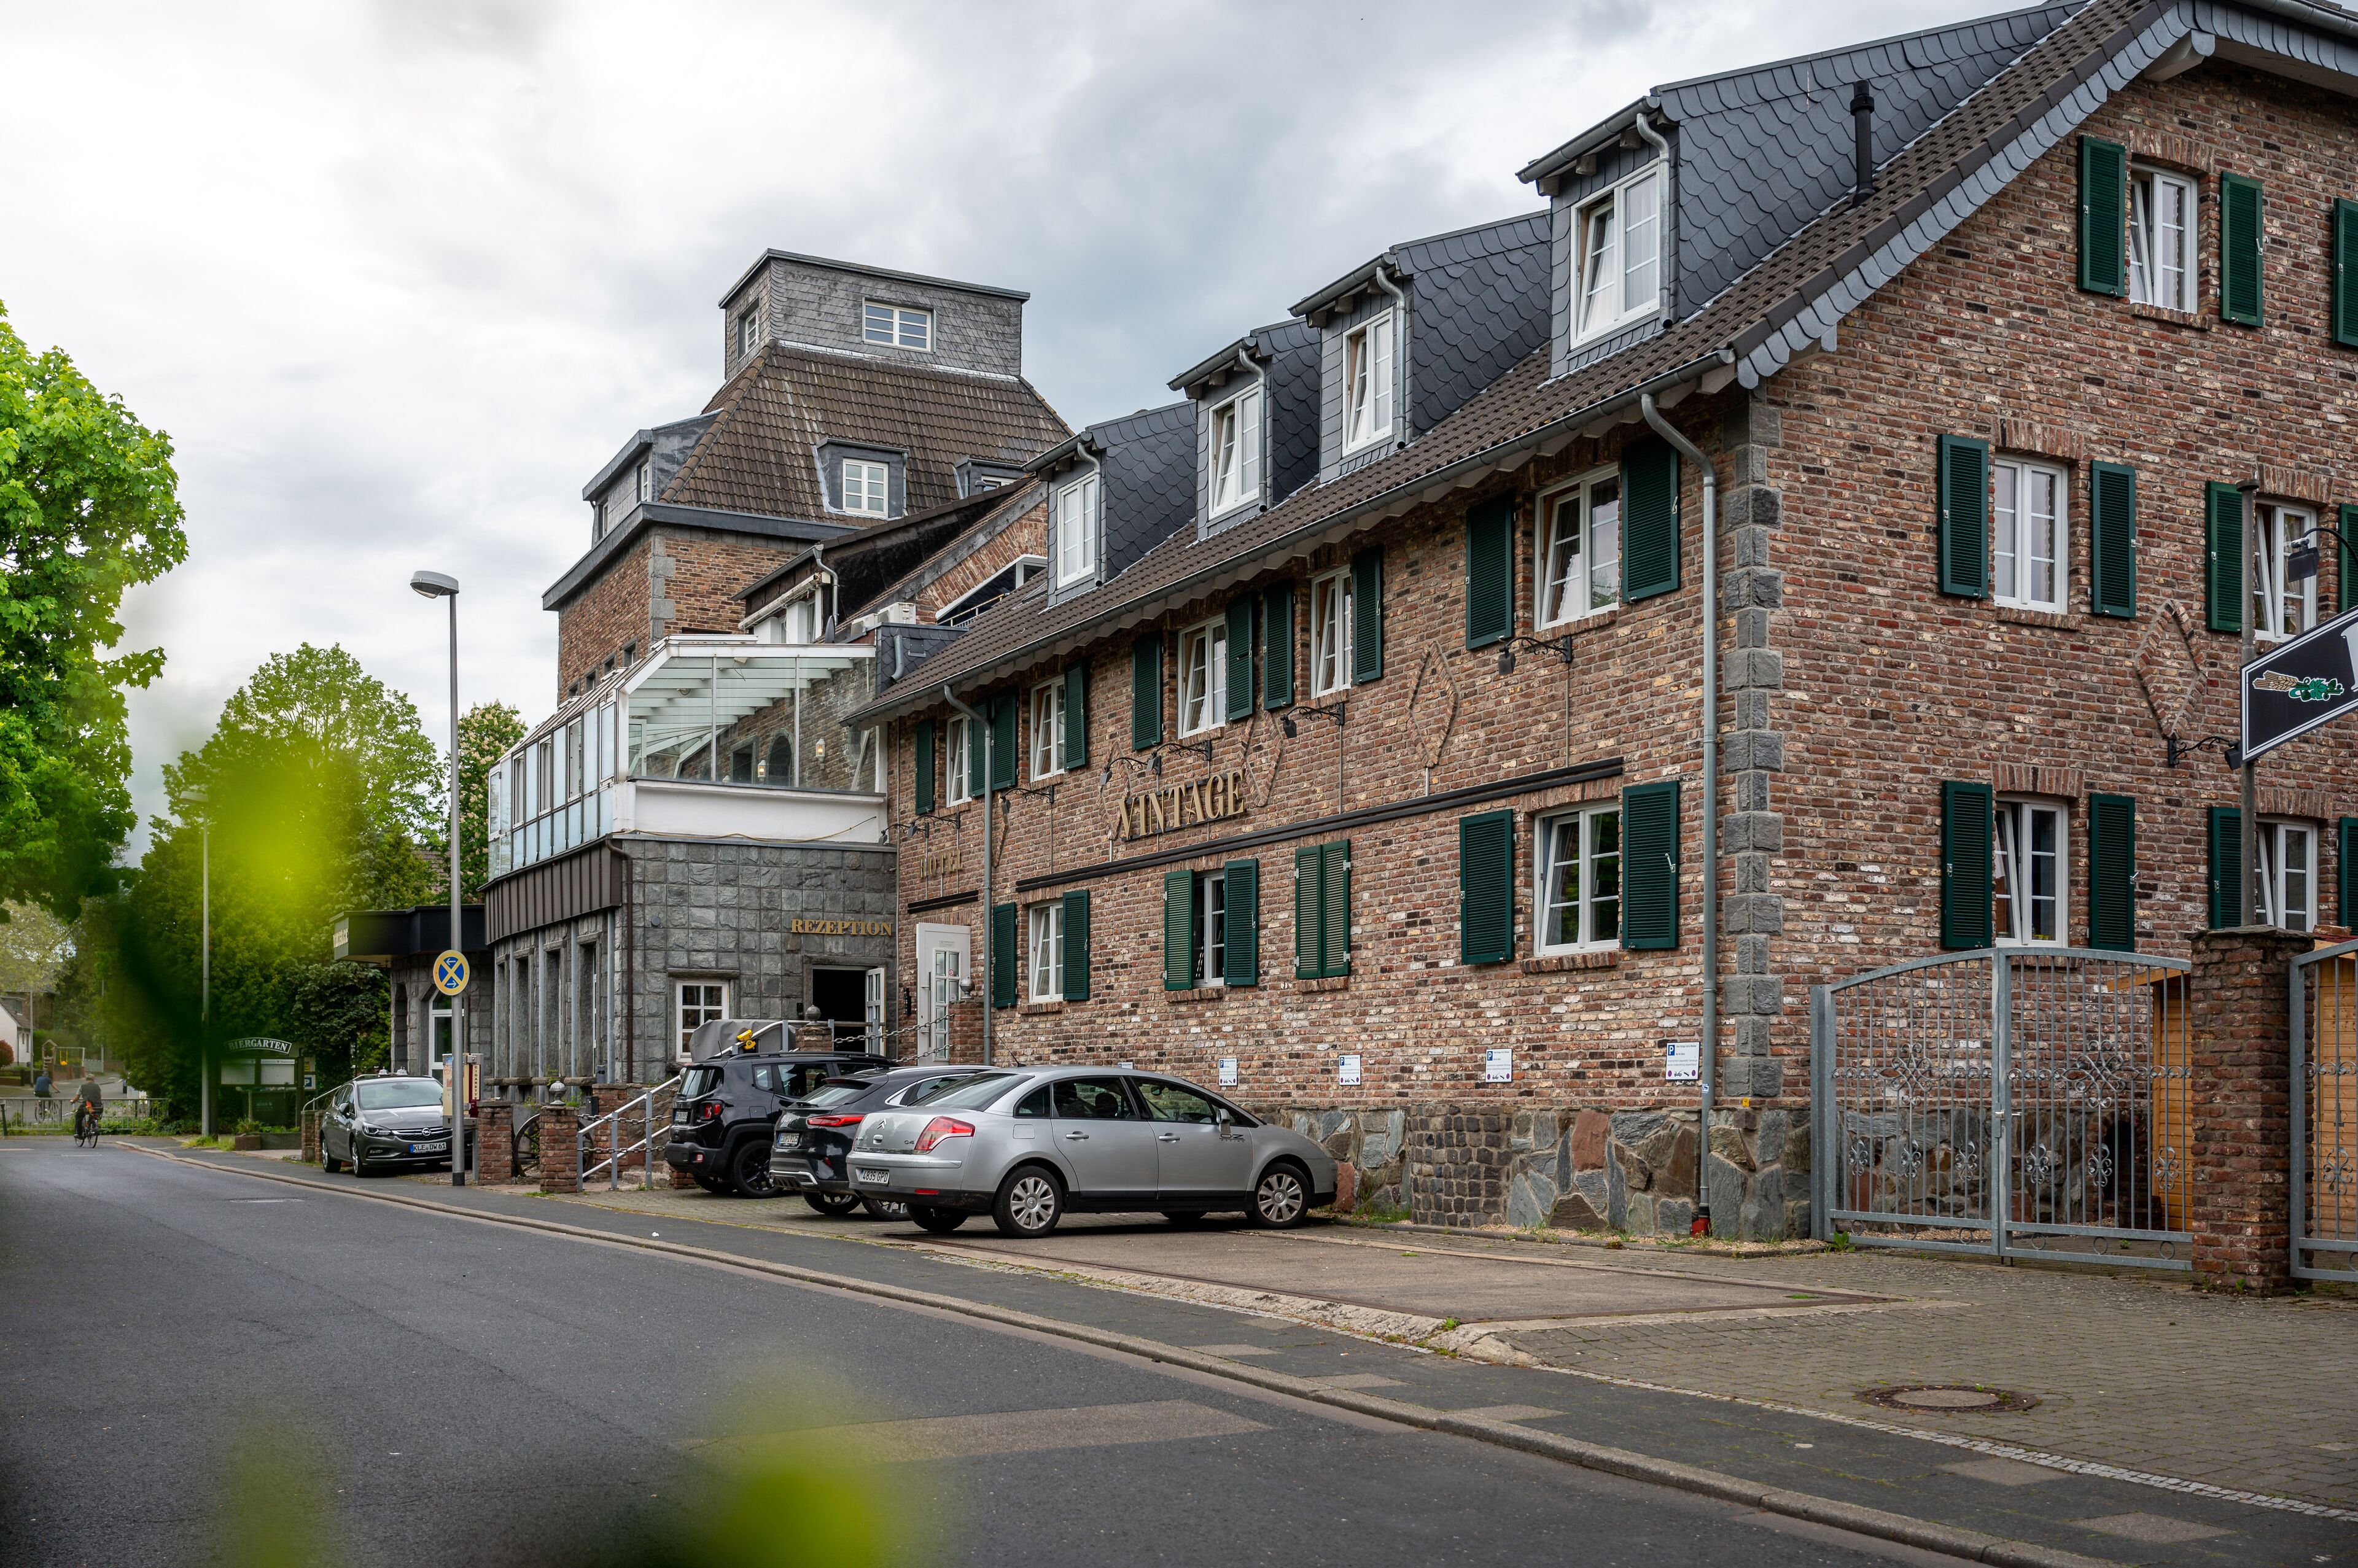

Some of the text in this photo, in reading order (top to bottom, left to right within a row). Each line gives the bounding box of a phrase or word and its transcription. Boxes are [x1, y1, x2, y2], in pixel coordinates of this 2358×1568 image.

[1118, 769, 1245, 840] VINTAGE
[919, 849, 963, 878] HOTEL
[790, 918, 893, 936] REZEPTION
[228, 1039, 288, 1052] BIERGARTEN
[1669, 1046, 1674, 1055] P
[1488, 1052, 1492, 1060] P
[862, 1170, 889, 1182] 4835 GPD
